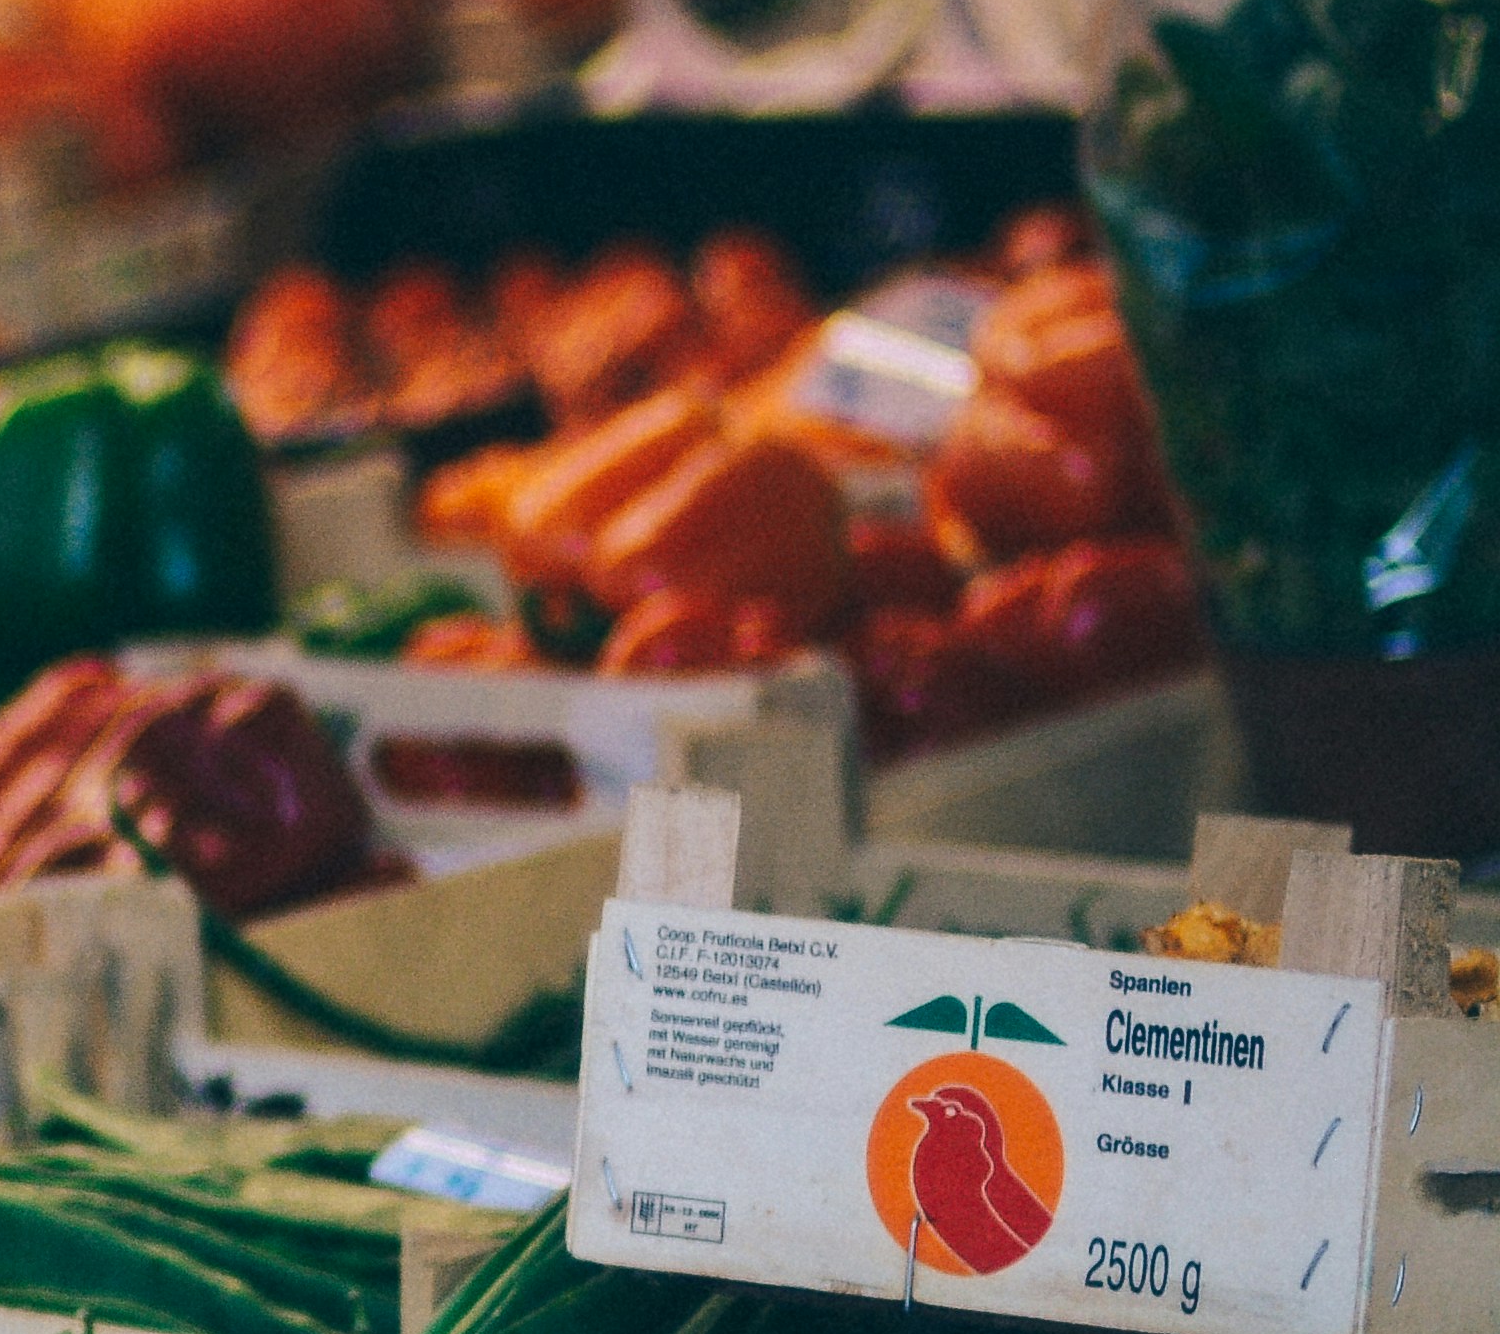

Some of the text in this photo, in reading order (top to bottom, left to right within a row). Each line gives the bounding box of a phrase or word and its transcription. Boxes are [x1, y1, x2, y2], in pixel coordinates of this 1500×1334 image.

[1109, 969, 1192, 997] Spanien
[1105, 1008, 1266, 1071] Clementinen
[1102, 1072, 1170, 1099] Klasse
[1096, 1132, 1170, 1159] Grösse
[1084, 1235, 1202, 1316] 2500 g
